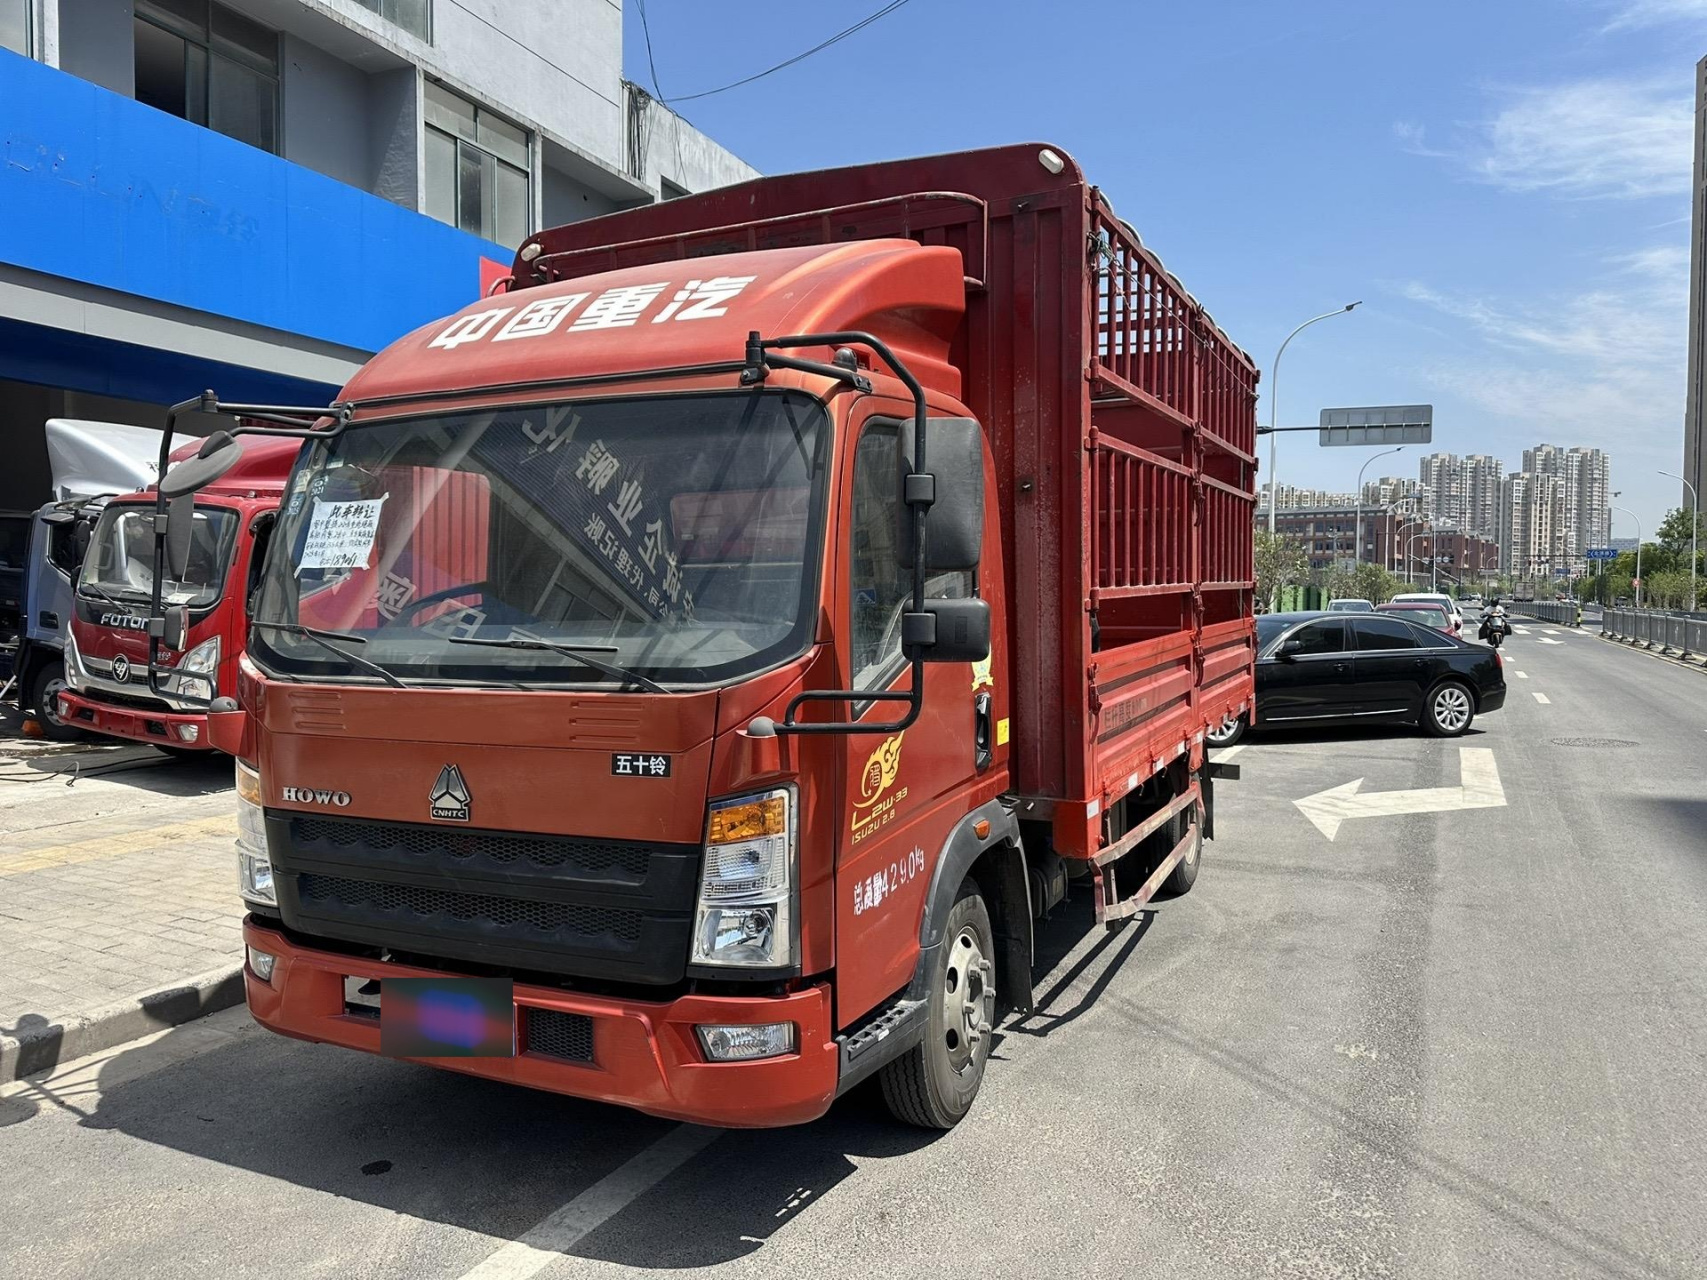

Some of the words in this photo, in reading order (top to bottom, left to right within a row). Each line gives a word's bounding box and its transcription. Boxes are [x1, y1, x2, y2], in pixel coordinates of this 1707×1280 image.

[427, 275, 757, 350] 中国重汽
[615, 755, 667, 776] 五十铃
[282, 787, 351, 807] HOWO
[432, 809, 465, 818] CNHTC
